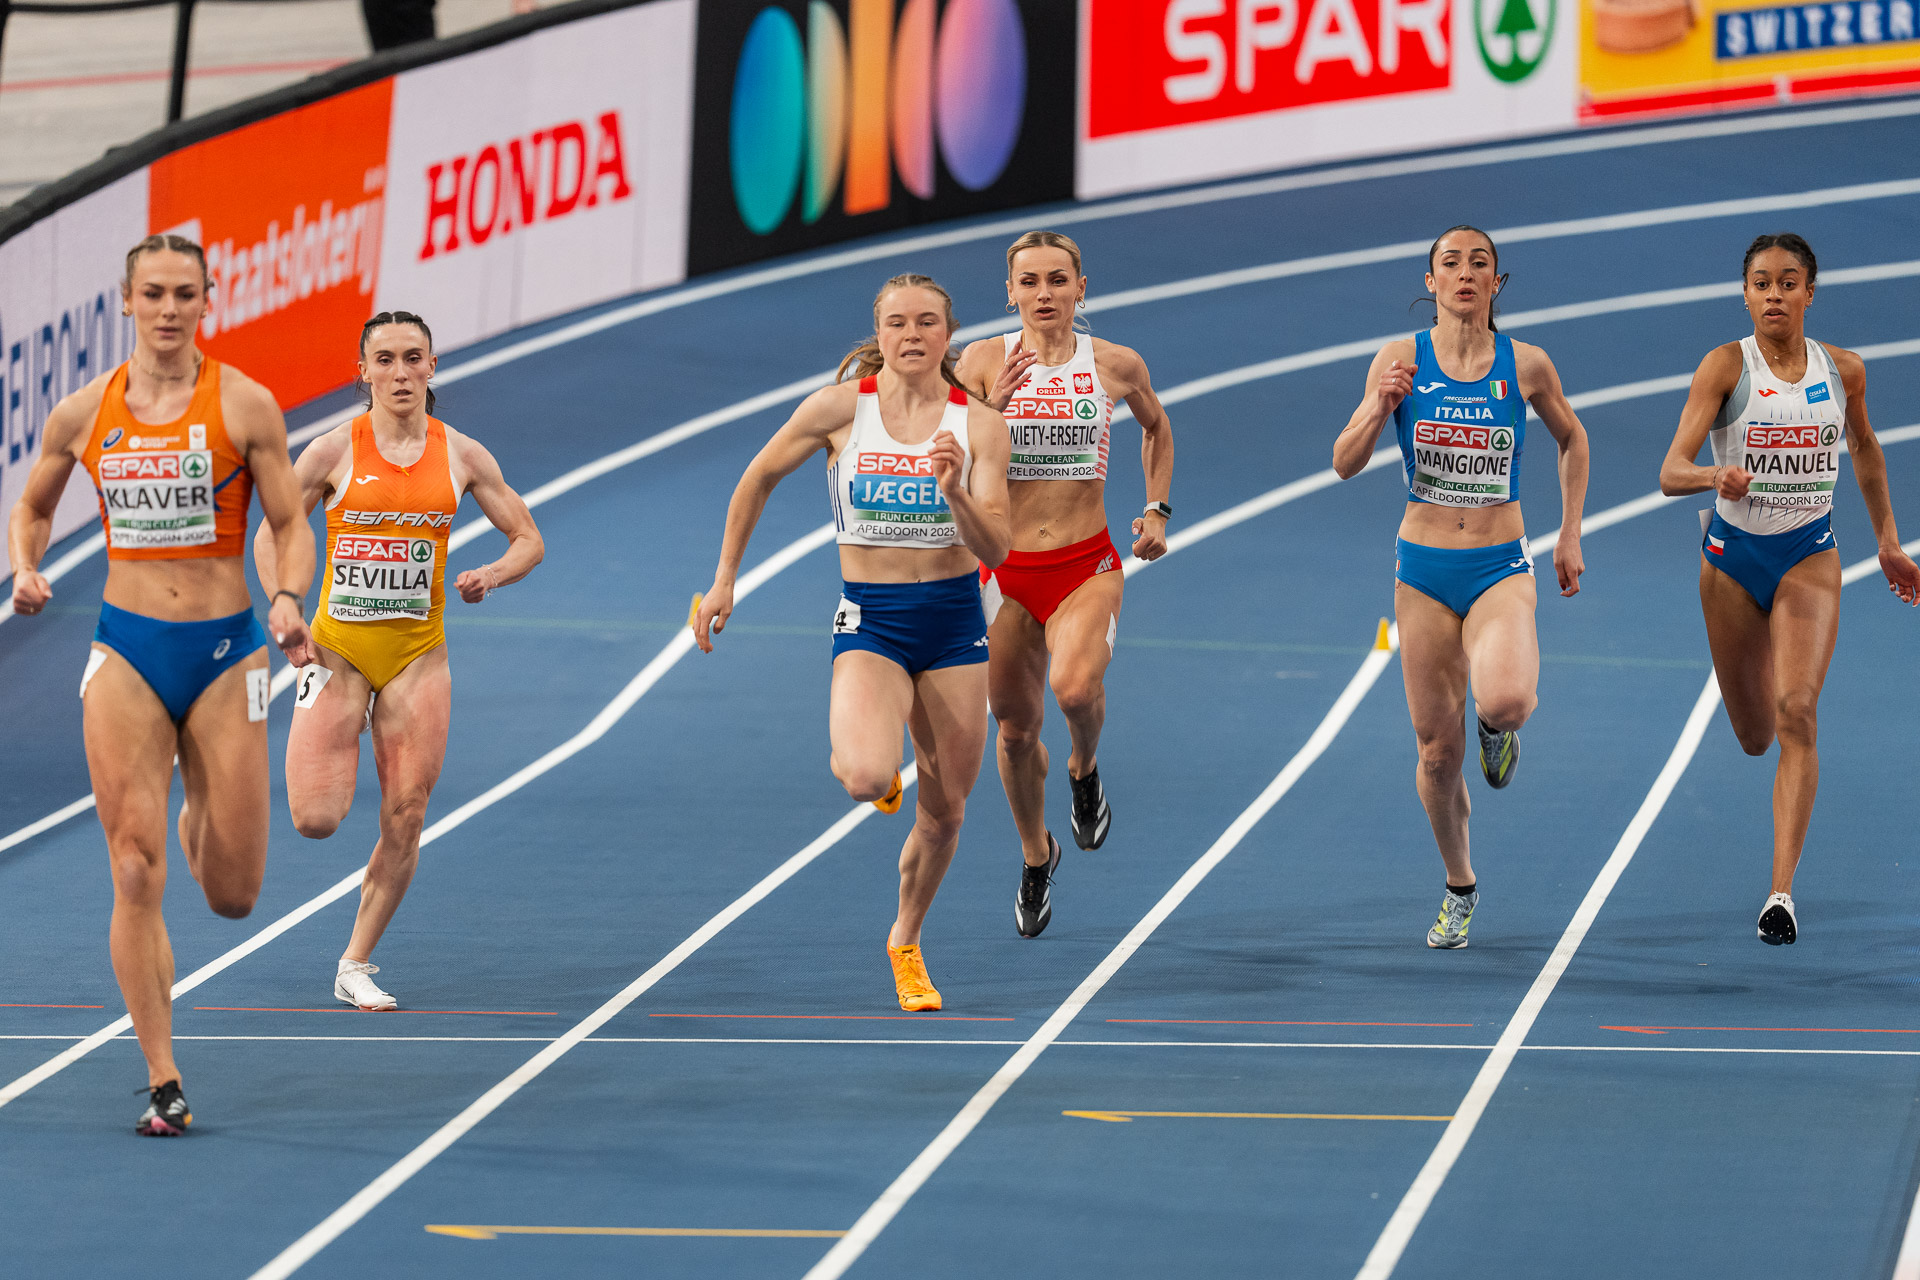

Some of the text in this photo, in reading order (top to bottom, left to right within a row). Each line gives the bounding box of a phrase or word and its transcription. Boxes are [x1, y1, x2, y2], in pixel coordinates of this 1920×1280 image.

[1163, 0, 1448, 104] SPAR
[417, 108, 634, 264] HONDA
[1003, 400, 1071, 416] SPAR
[1435, 407, 1494, 419] ITALIA
[1418, 425, 1487, 447] SPAR
[1749, 429, 1817, 446] SPAR
[102, 458, 178, 478] SPAR
[860, 455, 932, 474] SPAR
[1023, 455, 1044, 463] RUN
[1416, 448, 1509, 476] MANGIONE
[1744, 452, 1837, 475] MANUEL
[1436, 480, 1454, 489] RUN
[1767, 484, 1788, 492] RUN
[106, 486, 209, 509] KLAVER
[1416, 486, 1479, 504] APELDOORN
[342, 509, 455, 528] ESPAÑA
[881, 513, 900, 521] RUN
[857, 524, 955, 537] APELDOORN 2025
[337, 540, 407, 559] SPAR
[334, 564, 428, 590] SEVILLA
[354, 597, 375, 607] RUN
[299, 672, 315, 701] 5
